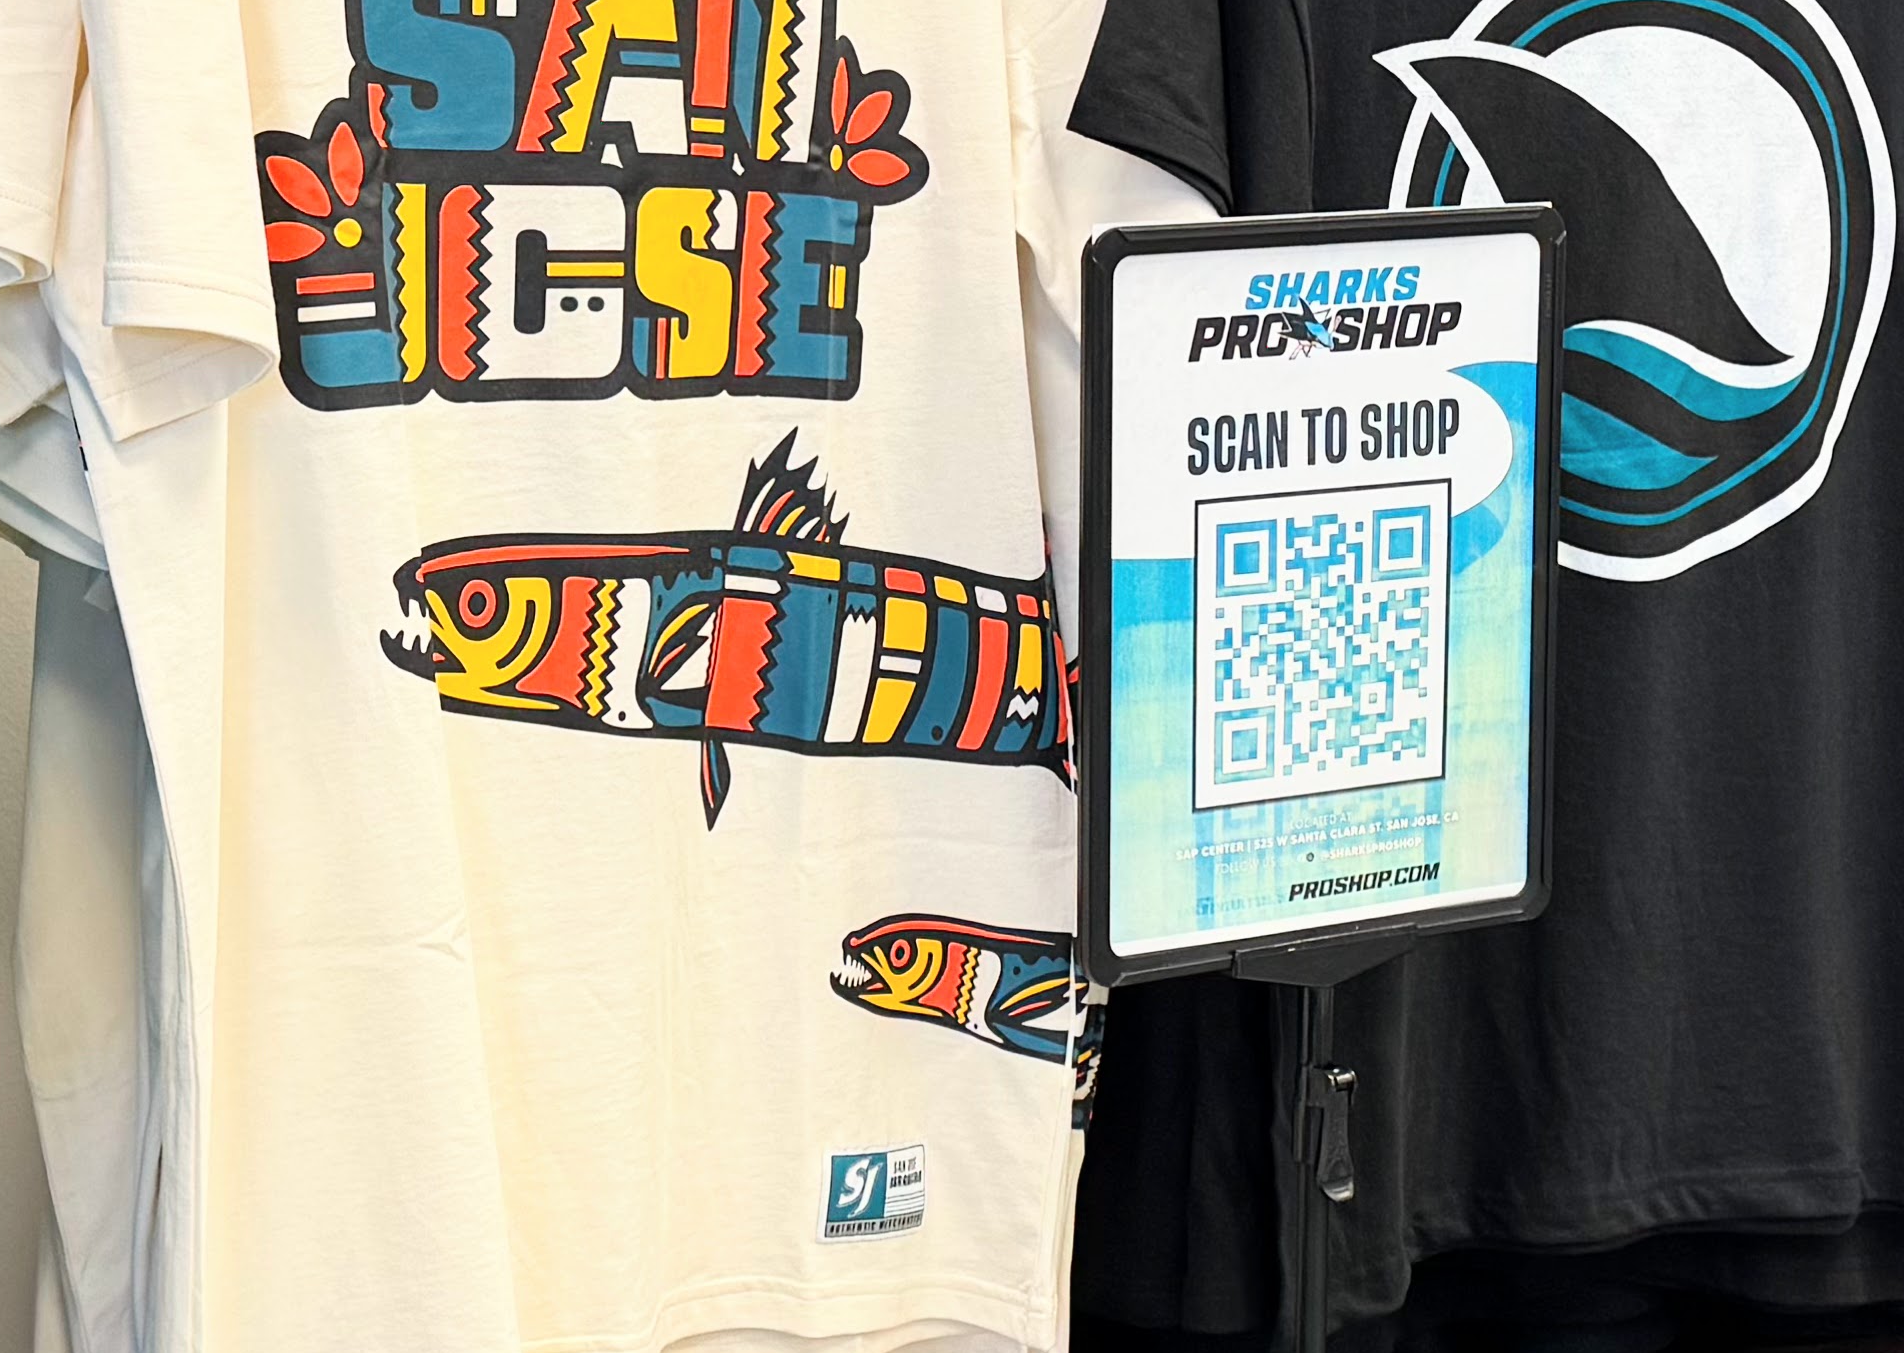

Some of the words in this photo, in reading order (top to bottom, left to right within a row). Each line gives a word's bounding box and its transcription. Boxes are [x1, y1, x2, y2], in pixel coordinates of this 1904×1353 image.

[1246, 265, 1421, 312] SHARKS
[1188, 313, 1288, 362] PRO
[1337, 301, 1462, 352] SHOP
[1187, 409, 1288, 475] SCAN
[1301, 406, 1346, 466] TO
[1360, 398, 1460, 461] SHOP
[1176, 848, 1198, 861] SAP
[1201, 841, 1244, 857] CENTER
[1254, 836, 1274, 851] 525
[1277, 835, 1289, 847] W
[1290, 831, 1327, 845] SANTA
[1329, 824, 1367, 840] CLARA
[1386, 818, 1409, 831] SAN
[1444, 811, 1459, 824] CA
[1288, 862, 1441, 902] PROSHOP.COM
